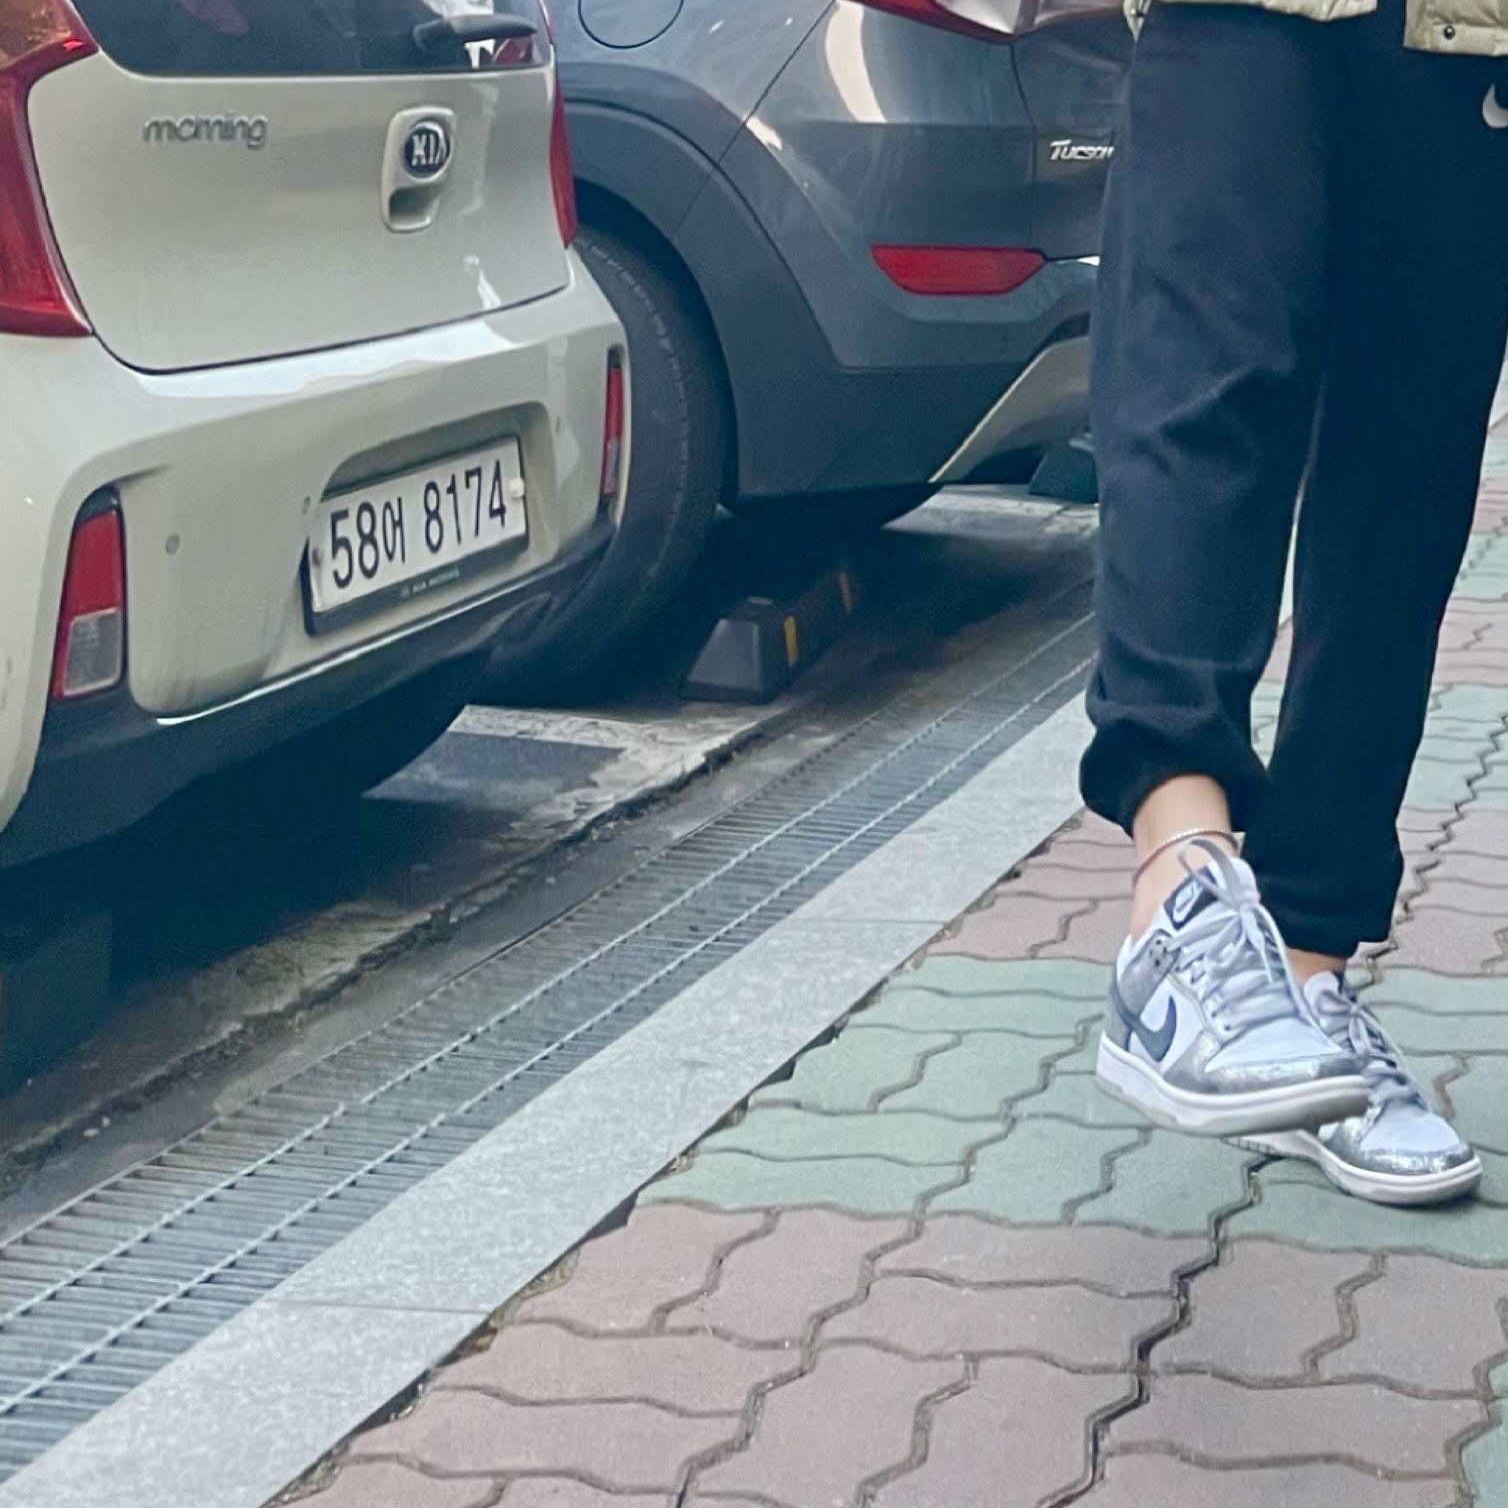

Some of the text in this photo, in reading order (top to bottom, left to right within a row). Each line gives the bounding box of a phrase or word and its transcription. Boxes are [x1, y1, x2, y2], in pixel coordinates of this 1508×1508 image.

[143, 109, 268, 149] morning
[412, 133, 448, 166] KIA
[330, 459, 507, 589] 58어 8174
